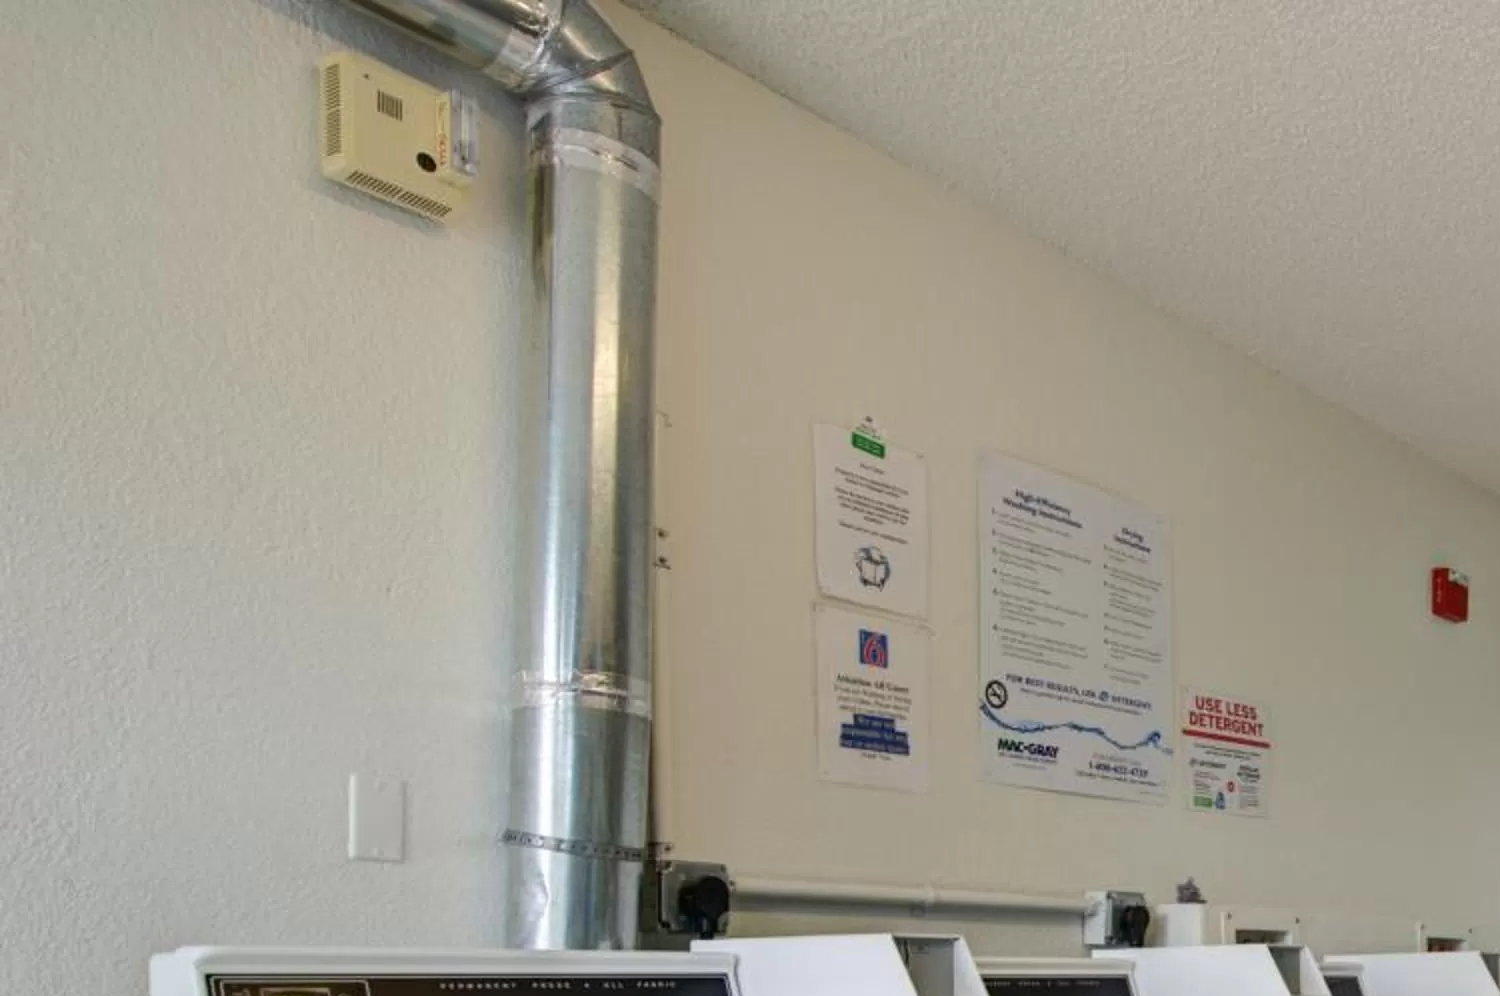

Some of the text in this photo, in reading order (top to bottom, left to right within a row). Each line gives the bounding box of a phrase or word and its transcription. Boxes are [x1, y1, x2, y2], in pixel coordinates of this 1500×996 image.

[1195, 695, 1257, 720] USE LESS
[1189, 711, 1264, 737] DETERGENT
